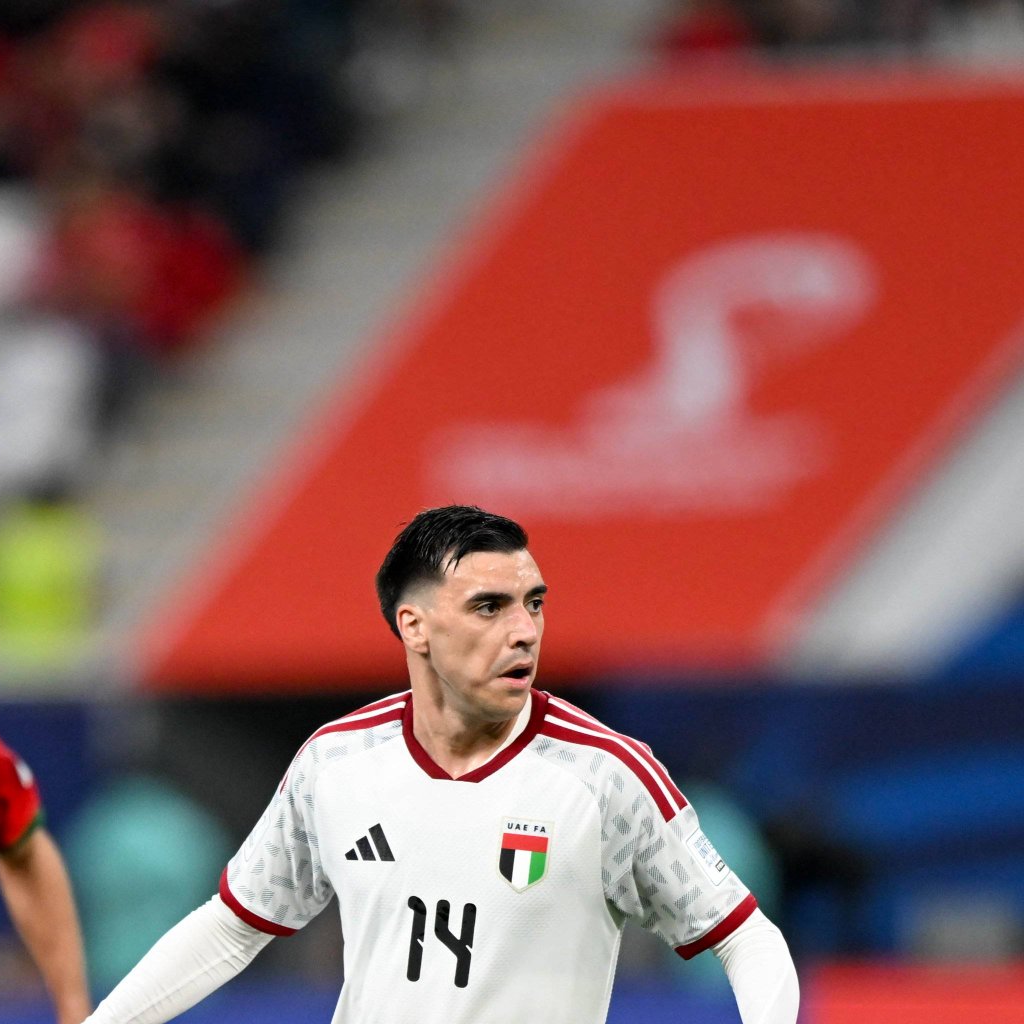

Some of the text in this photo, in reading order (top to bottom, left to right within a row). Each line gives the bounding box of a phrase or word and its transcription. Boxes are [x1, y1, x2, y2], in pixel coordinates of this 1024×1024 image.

[507, 822, 547, 834] UAE FA
[406, 895, 477, 989] 14
